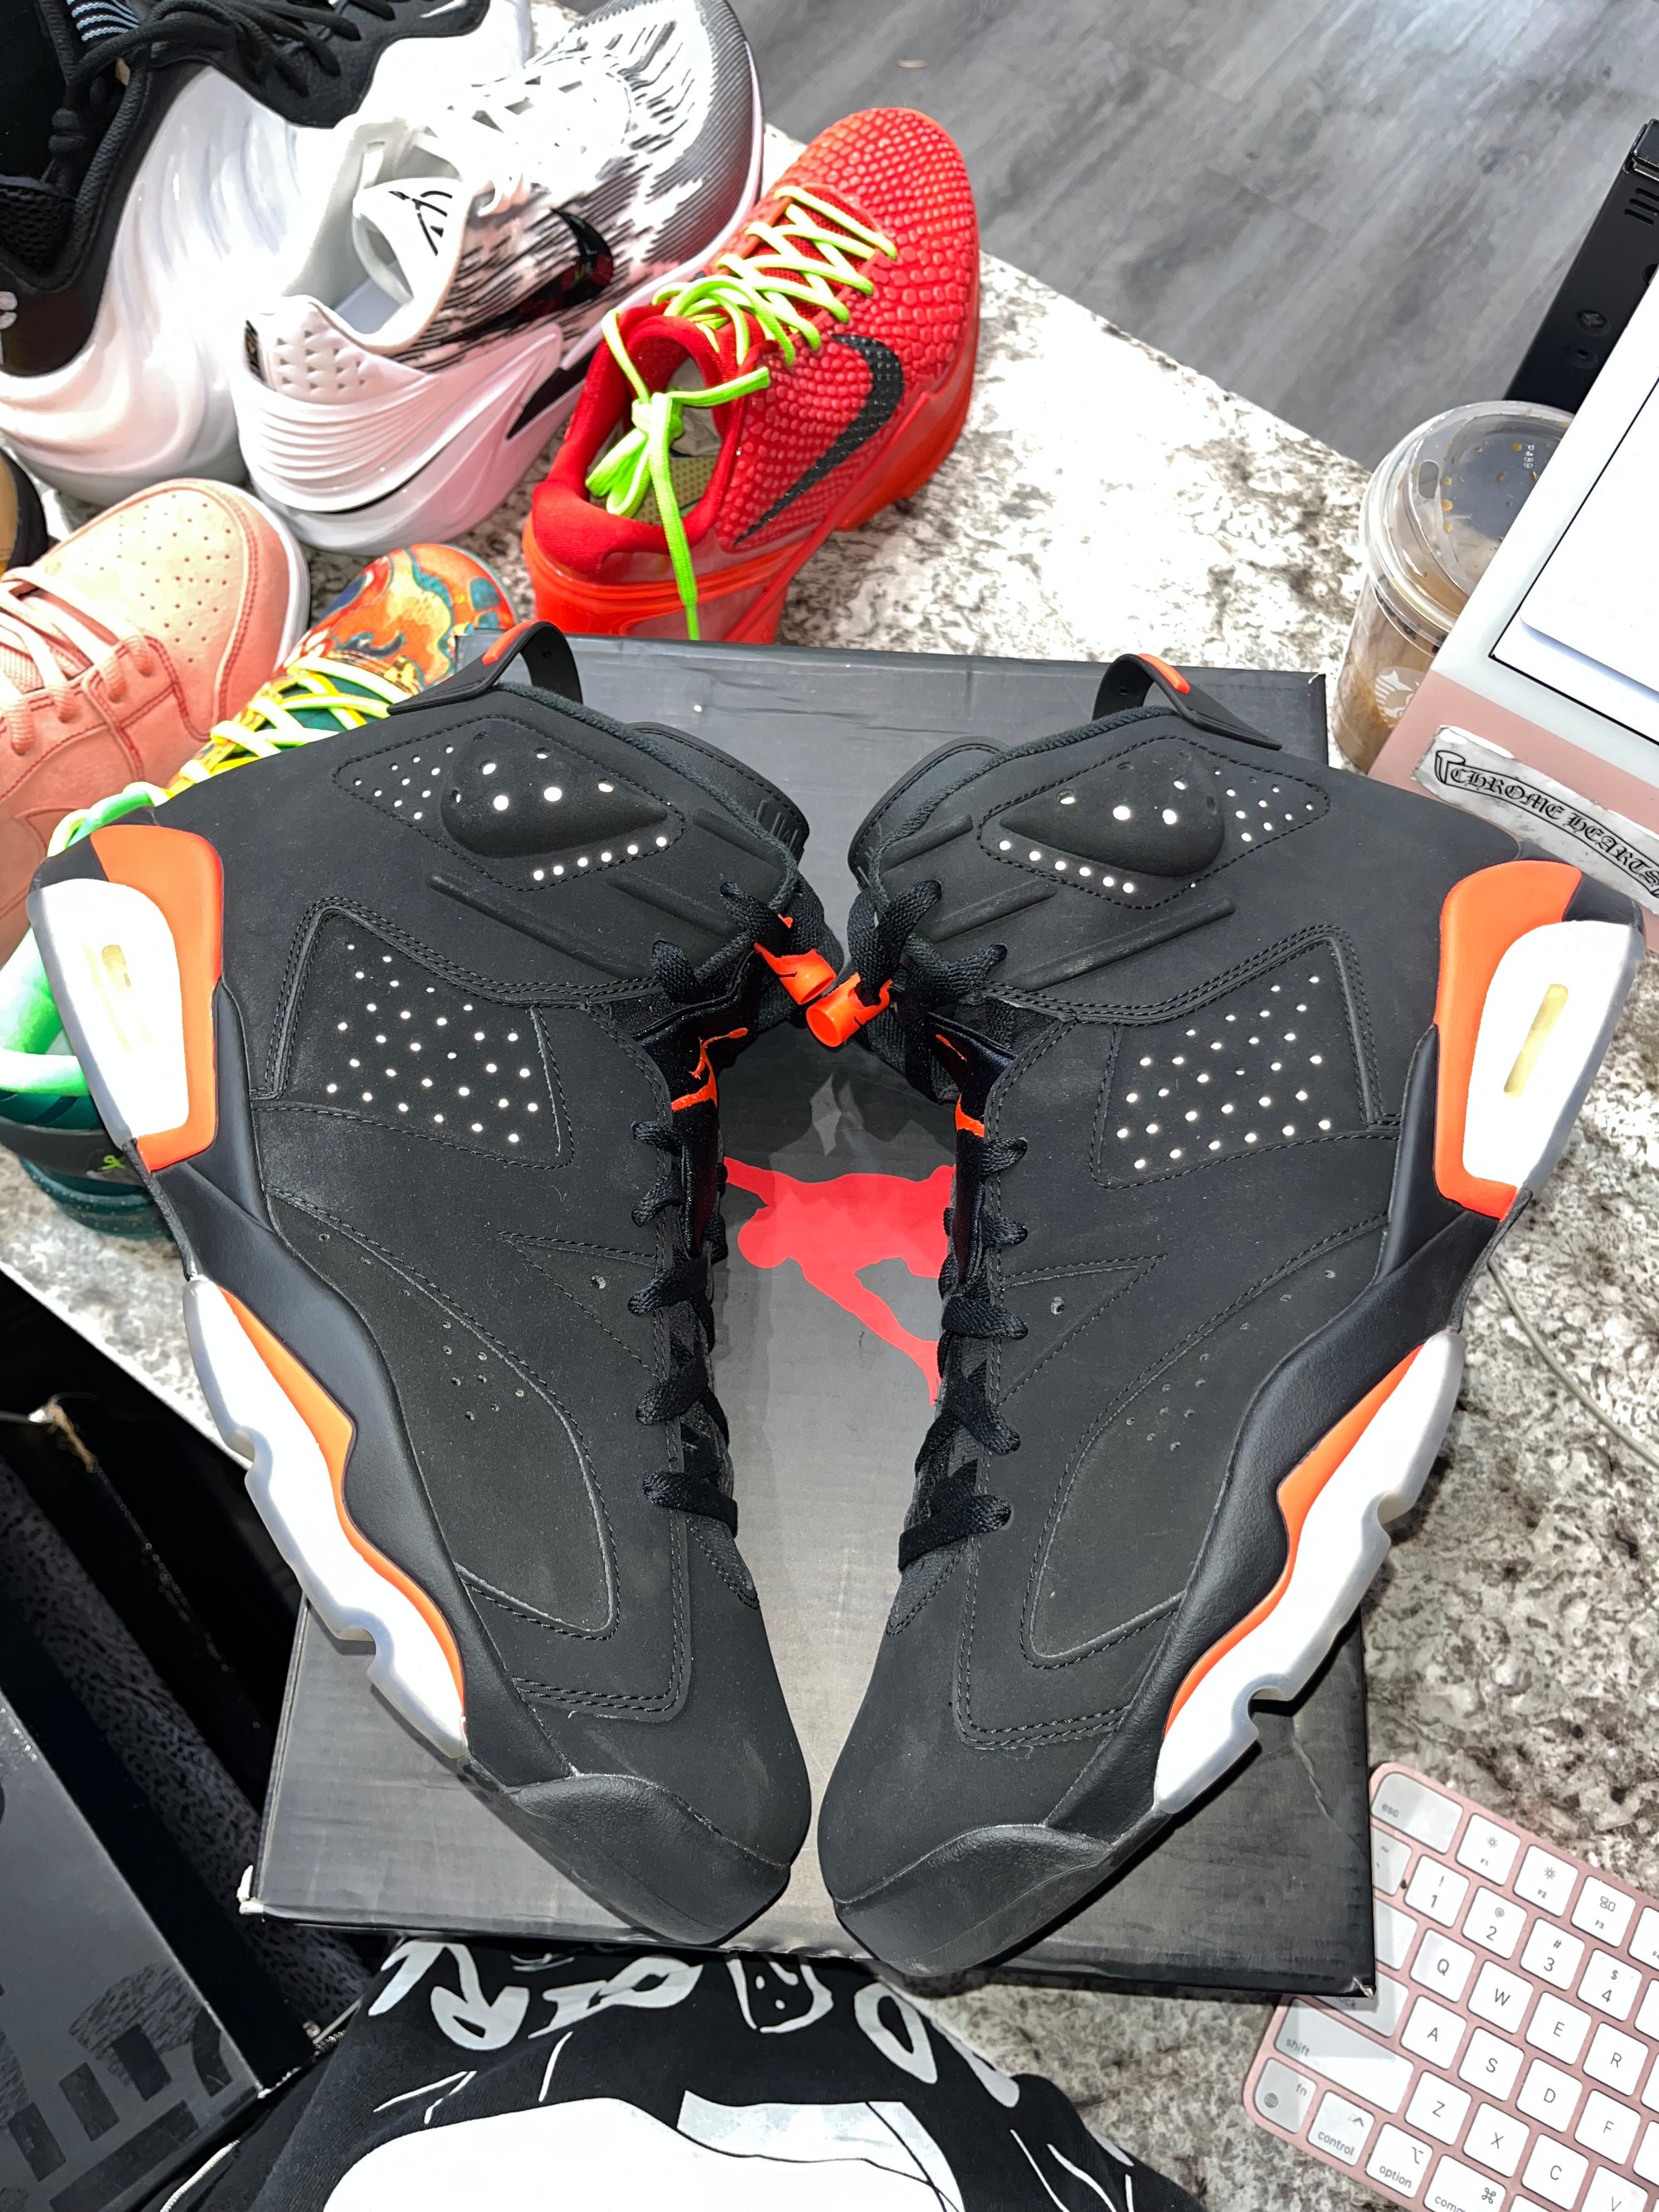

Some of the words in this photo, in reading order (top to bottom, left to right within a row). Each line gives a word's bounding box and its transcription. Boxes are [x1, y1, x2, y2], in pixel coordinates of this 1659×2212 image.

[1450, 768, 1565, 820] CHROME
[1563, 812, 1659, 887] HEARTS
[1381, 1803, 1399, 1818] esc
[1480, 1858, 1489, 1866] F1
[1431, 1894, 1438, 1908] 1
[1537, 1889, 1548, 1899] F2
[1494, 1907, 1506, 1918] @
[1594, 1919, 1605, 1930] F3
[1486, 1925, 1497, 1942] 2
[1553, 1939, 1562, 1949] #
[1437, 1958, 1450, 1976] Q
[1543, 1957, 1555, 1972] 3
[1610, 1969, 1619, 1981] $
[1335, 1997, 1358, 2010] ock
[1494, 1988, 1511, 2006] W
[1601, 1989, 1613, 2003] 4
[1427, 2027, 1438, 2043] A
[1553, 2021, 1565, 2037] E
[1285, 2037, 1311, 2057] shift
[1486, 2057, 1498, 2073] S
[1610, 2051, 1623, 2069] R
[1296, 2083, 1307, 2097] fn
[1543, 2088, 1556, 2103] D
[1432, 2100, 1446, 2117] Z
[1603, 2120, 1614, 2134] F
[1317, 2129, 1355, 2156] control
[1490, 2132, 1505, 2150] X
[1379, 2165, 1413, 2189] option
[1550, 2165, 1563, 2181] C
[1611, 2196, 1623, 2212] V
